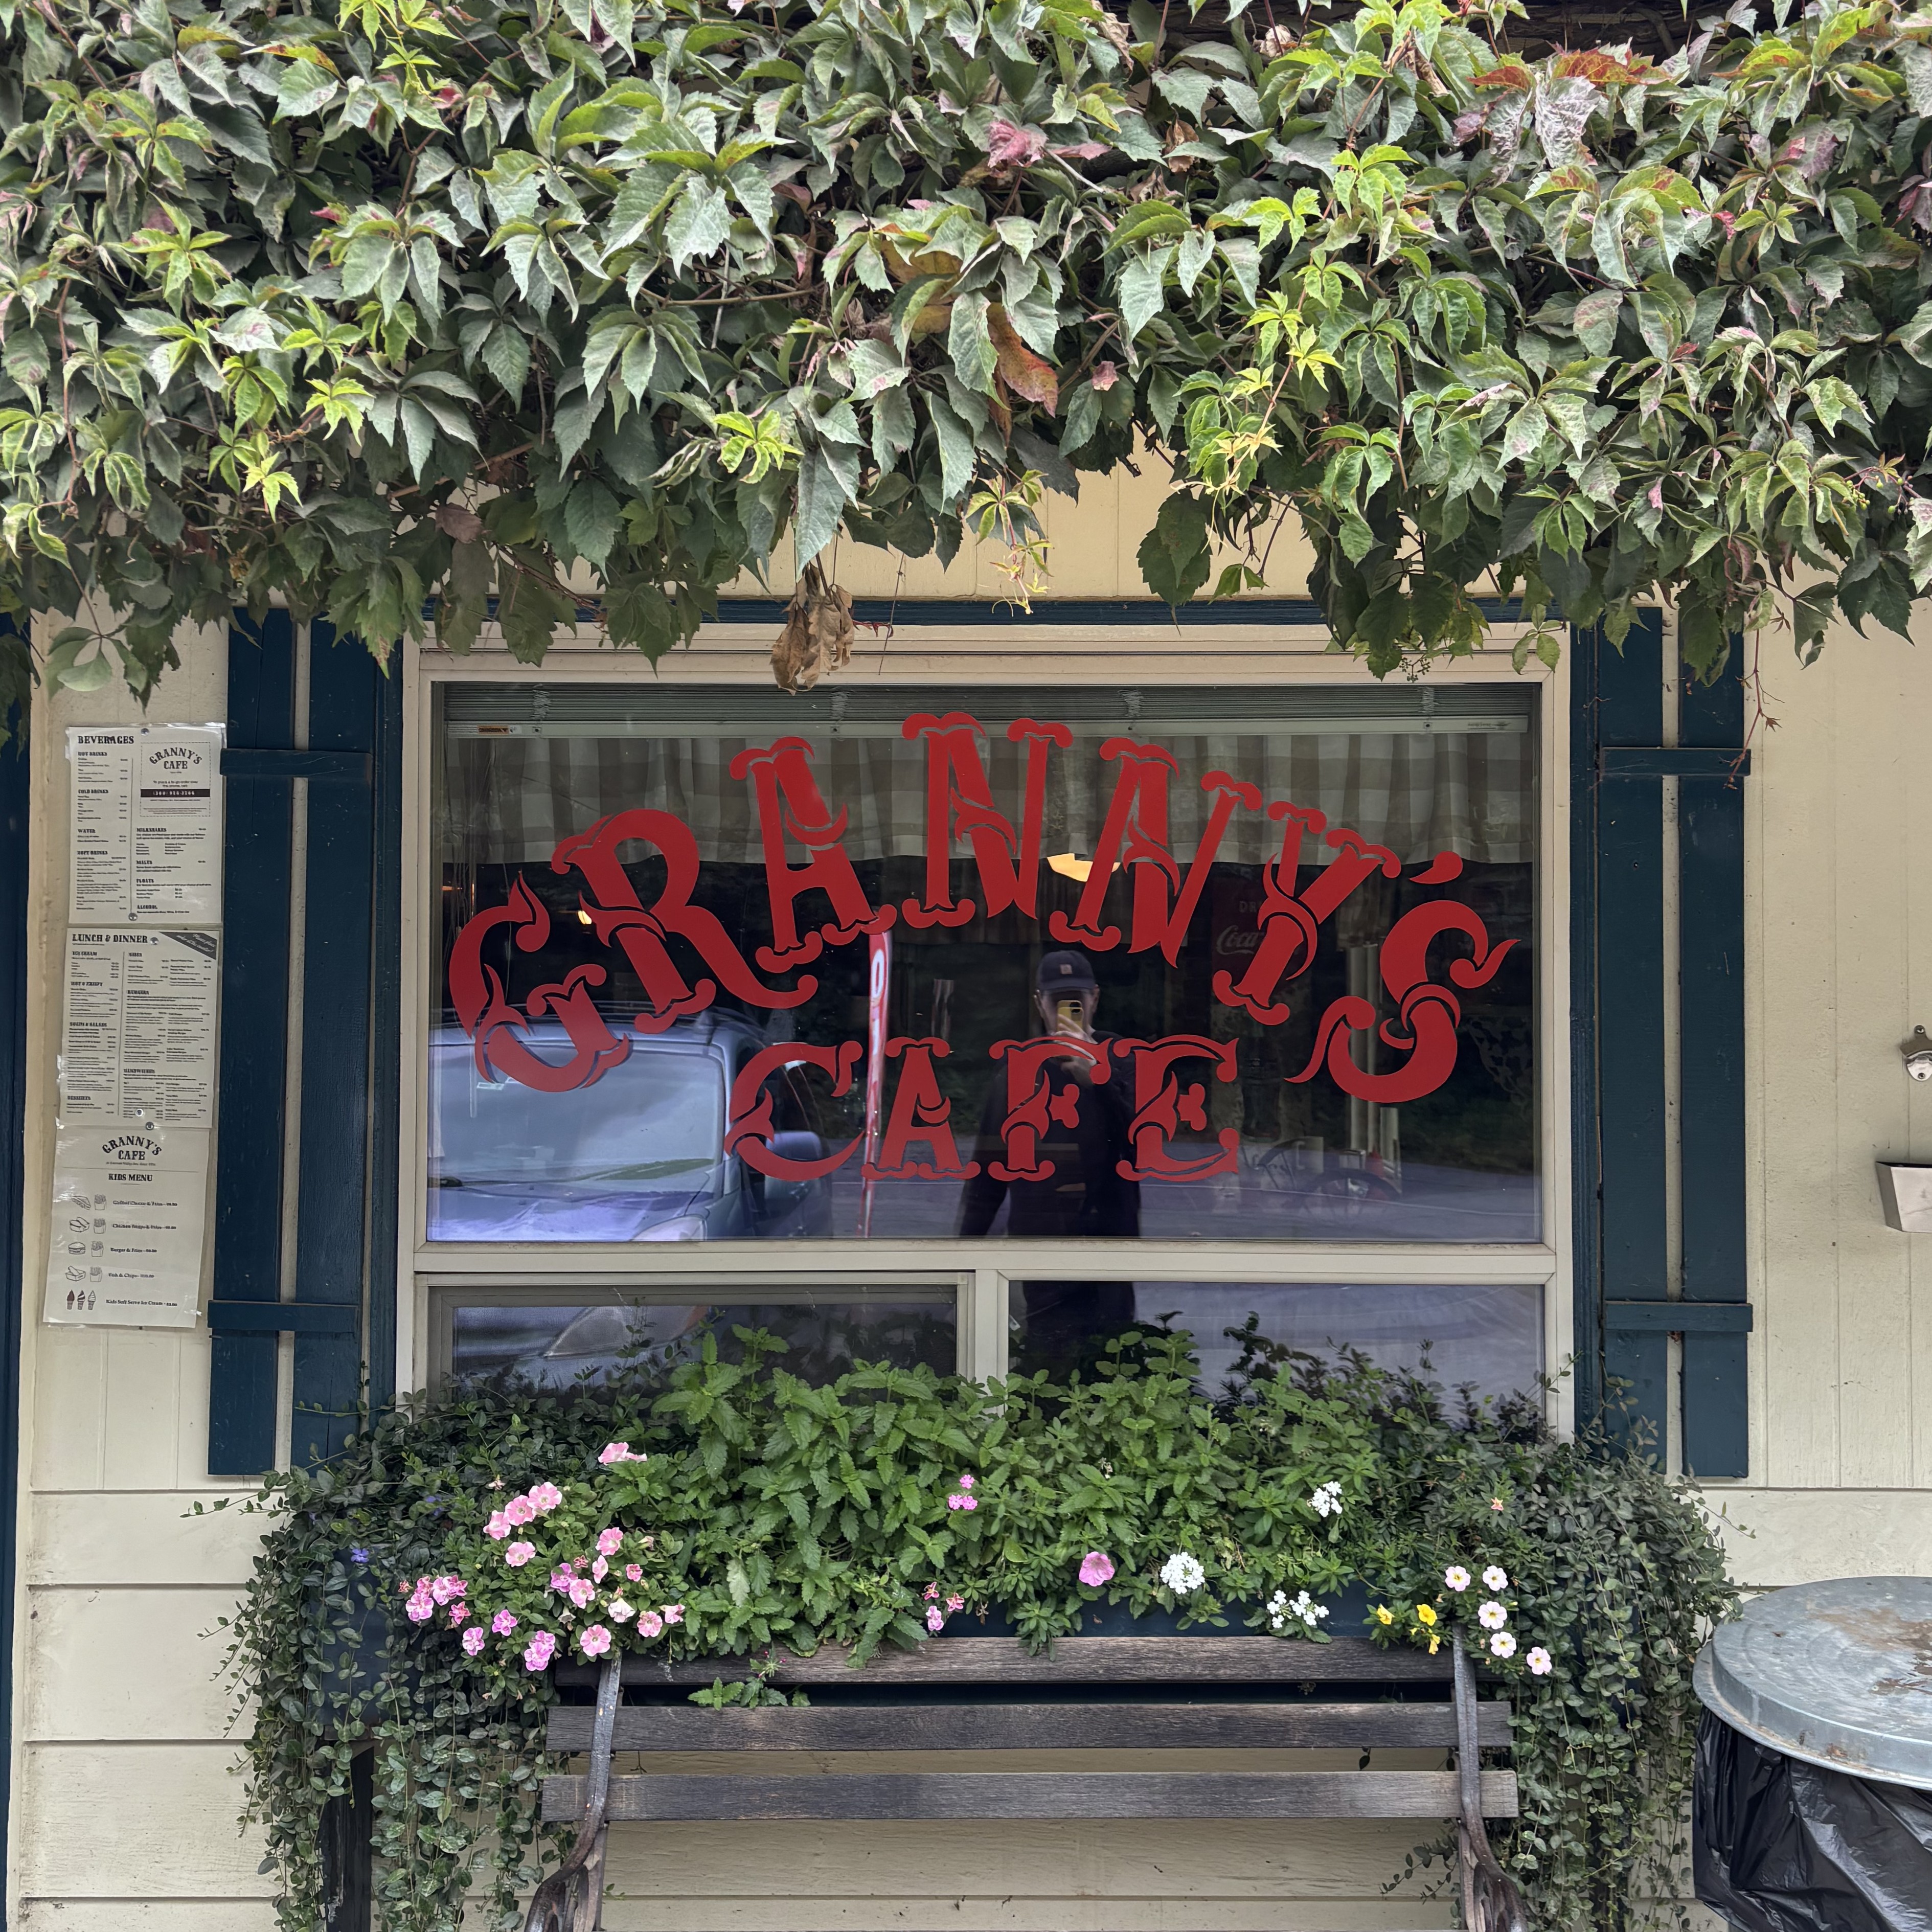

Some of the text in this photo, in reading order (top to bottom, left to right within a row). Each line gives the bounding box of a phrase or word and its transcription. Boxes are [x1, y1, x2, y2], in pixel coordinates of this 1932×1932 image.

[78, 736, 134, 744] BEVERAGES
[149, 747, 202, 764] GRANNY'S
[164, 761, 188, 769] CAFE
[449, 712, 1518, 1103] GRANNY'S
[113, 935, 148, 943] DINNER
[723, 1035, 1240, 1181] CAFE
[102, 1135, 162, 1155] GRANNY'S
[118, 1150, 145, 1160] CAFE
